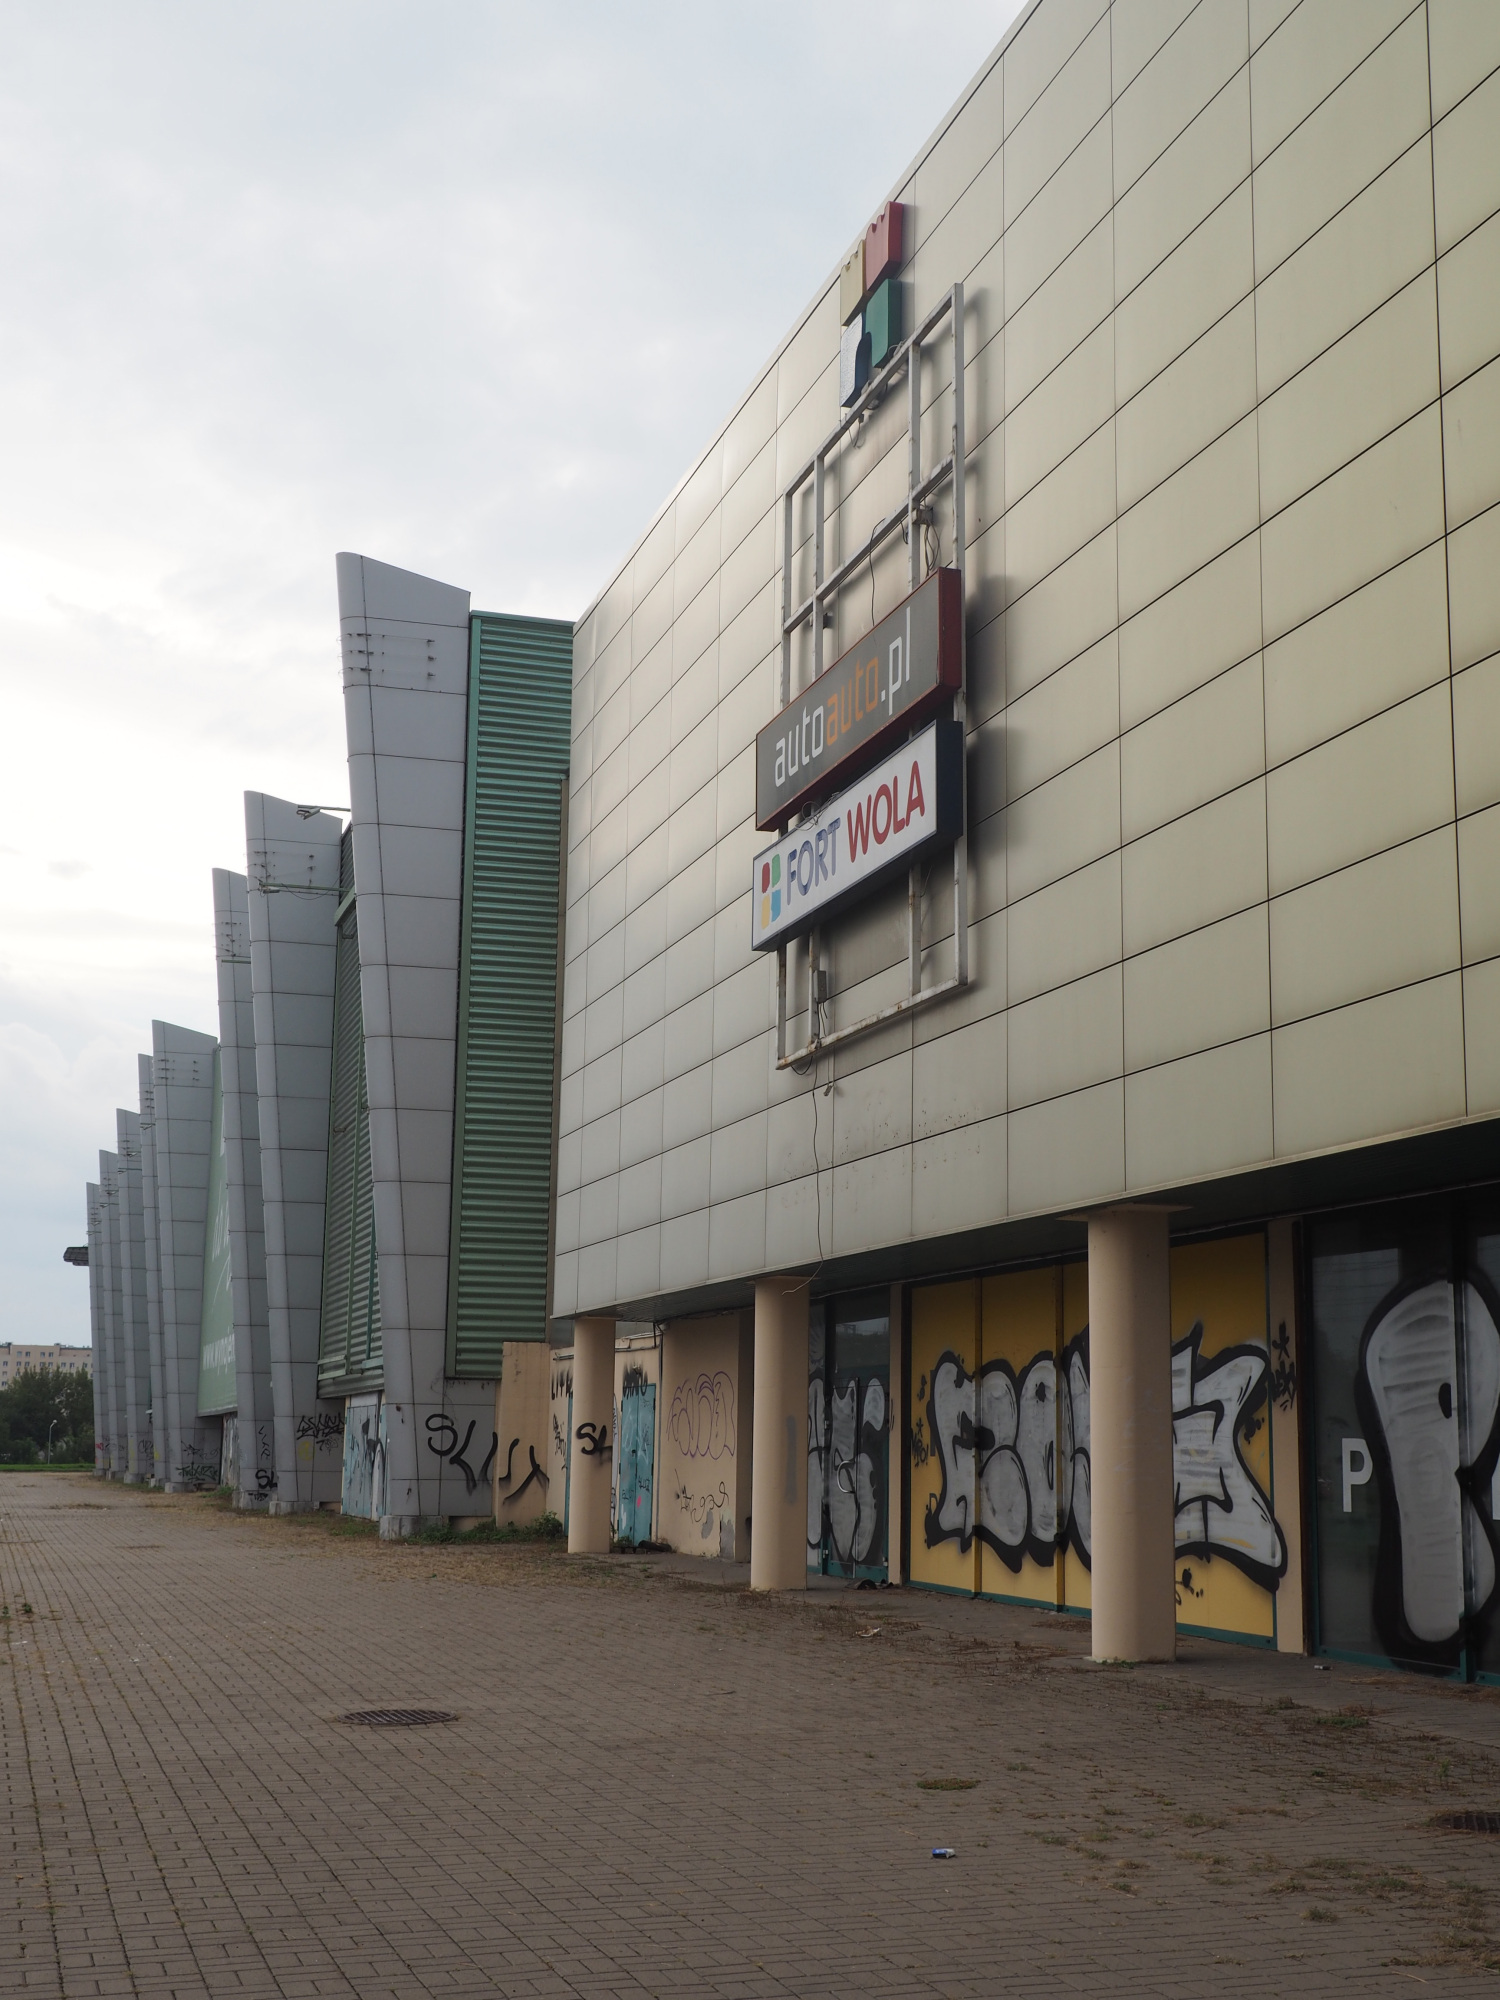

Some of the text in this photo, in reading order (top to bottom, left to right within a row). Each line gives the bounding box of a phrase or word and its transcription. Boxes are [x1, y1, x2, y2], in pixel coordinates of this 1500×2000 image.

[775, 607, 911, 787] autoauto.pl
[787, 760, 925, 905] FORT WOLA
